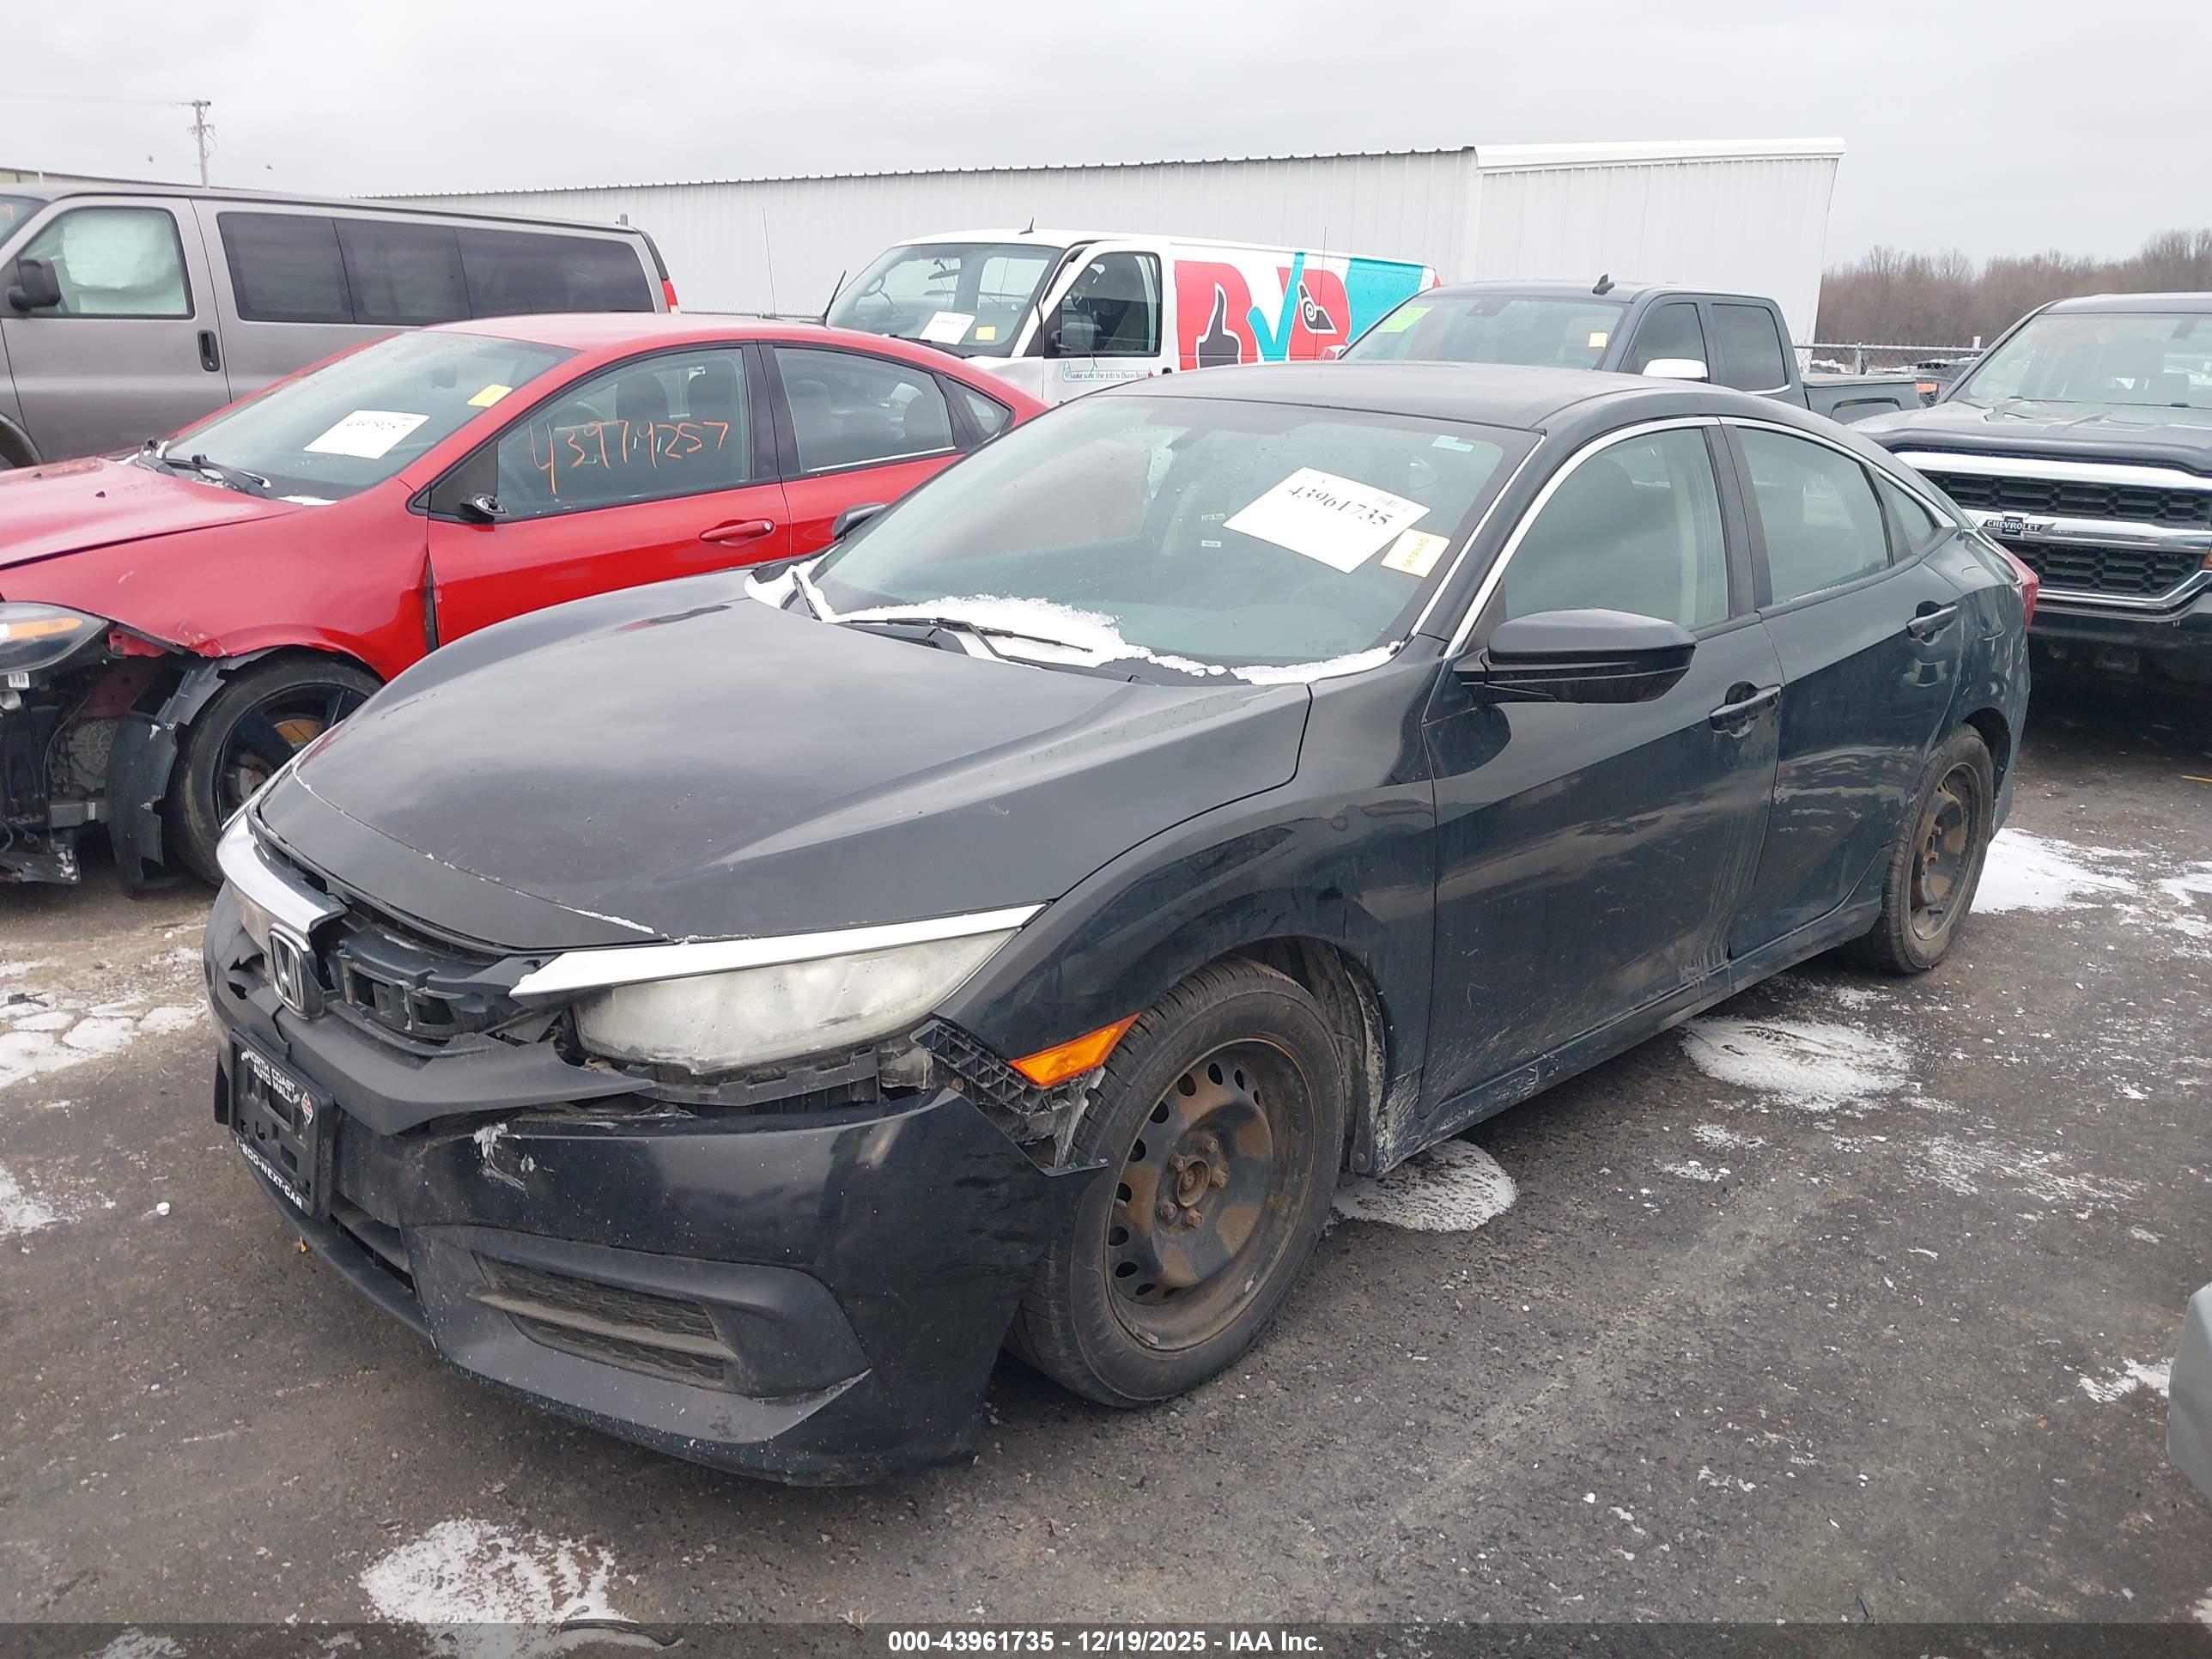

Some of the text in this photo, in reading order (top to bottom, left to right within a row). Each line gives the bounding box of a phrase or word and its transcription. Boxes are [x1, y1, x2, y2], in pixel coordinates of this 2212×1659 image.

[1287, 485, 1394, 526] 43961735
[1986, 519, 2040, 532] CHEVROLET
[246, 1048, 295, 1094] NORTH COAST
[253, 1064, 293, 1103] AUTO MALL
[235, 1137, 302, 1209] 1-800-NEXT-CAR
